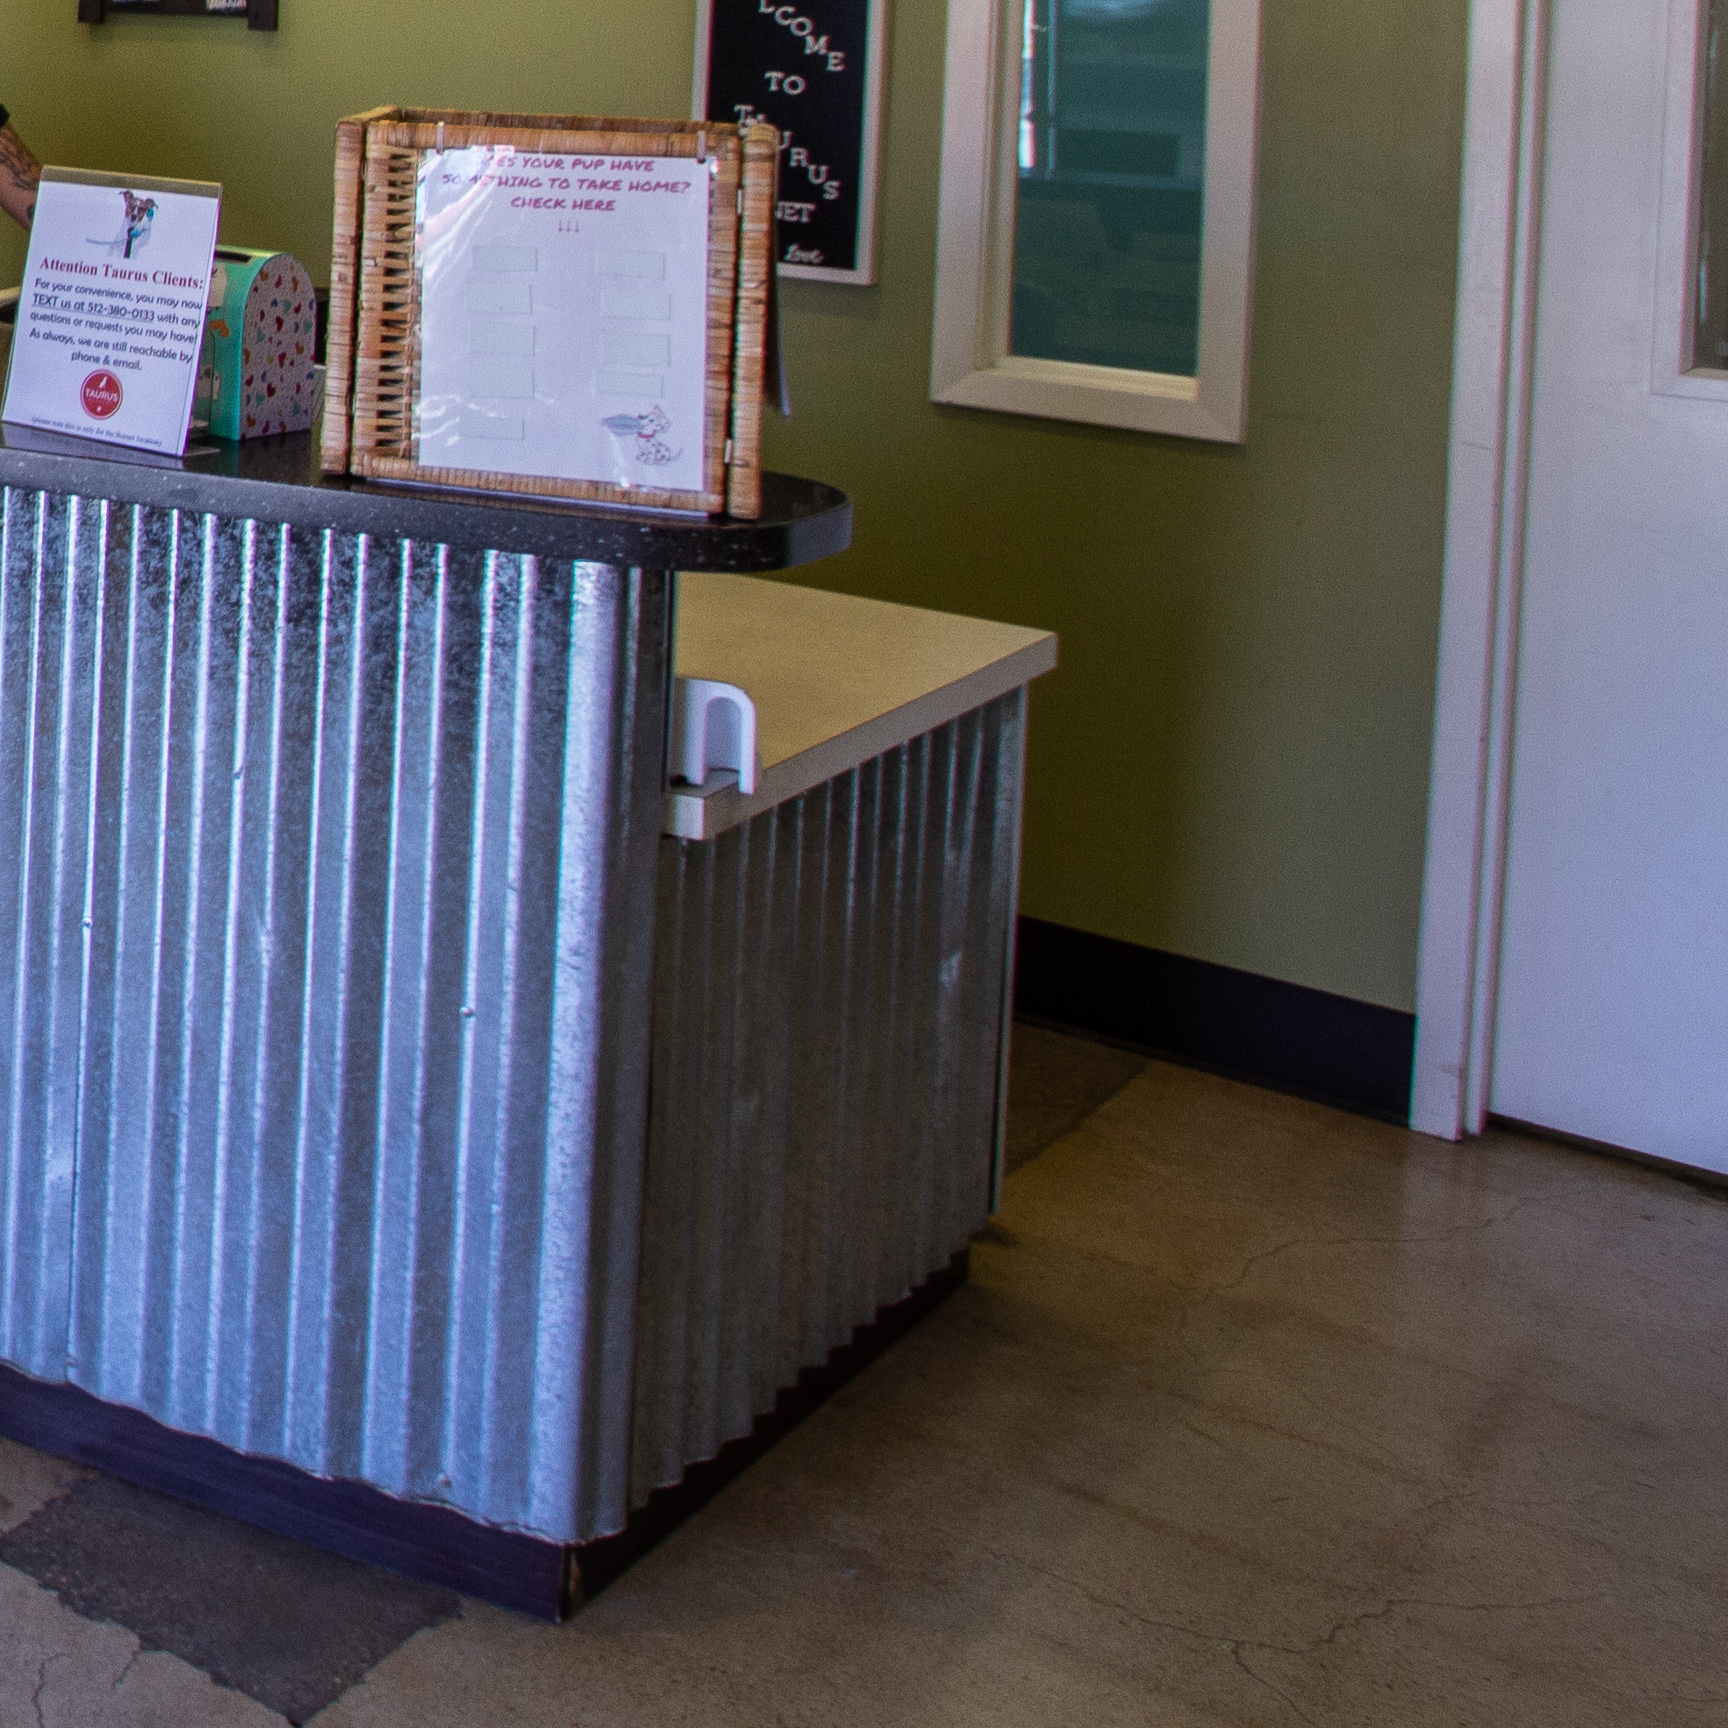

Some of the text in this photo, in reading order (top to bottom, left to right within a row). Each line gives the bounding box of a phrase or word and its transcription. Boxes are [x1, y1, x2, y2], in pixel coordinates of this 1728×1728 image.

[764, 71, 807, 95] TO
[522, 157, 565, 170] YOUR
[571, 158, 605, 171] PUP
[610, 160, 655, 172] HAVE
[548, 177, 570, 189] TO
[577, 178, 623, 191] TAKE
[628, 180, 692, 193] HOME?
[510, 196, 616, 211] CHECK HERE
[39, 257, 204, 289] Attention Taurus Clients:
[34, 278, 203, 310] For your convenience, you may now
[33, 293, 200, 328] TEXT us at 512-380-0133 with any
[30, 312, 71, 326] questions
[73, 319, 84, 327] or
[85, 320, 123, 333] requests
[124, 326, 143, 336] you
[145, 328, 167, 340] may
[30, 328, 193, 364] As always, we are still reachable by
[71, 351, 100, 364] phone
[102, 354, 110, 365] &
[85, 388, 119, 403] TAURUS
